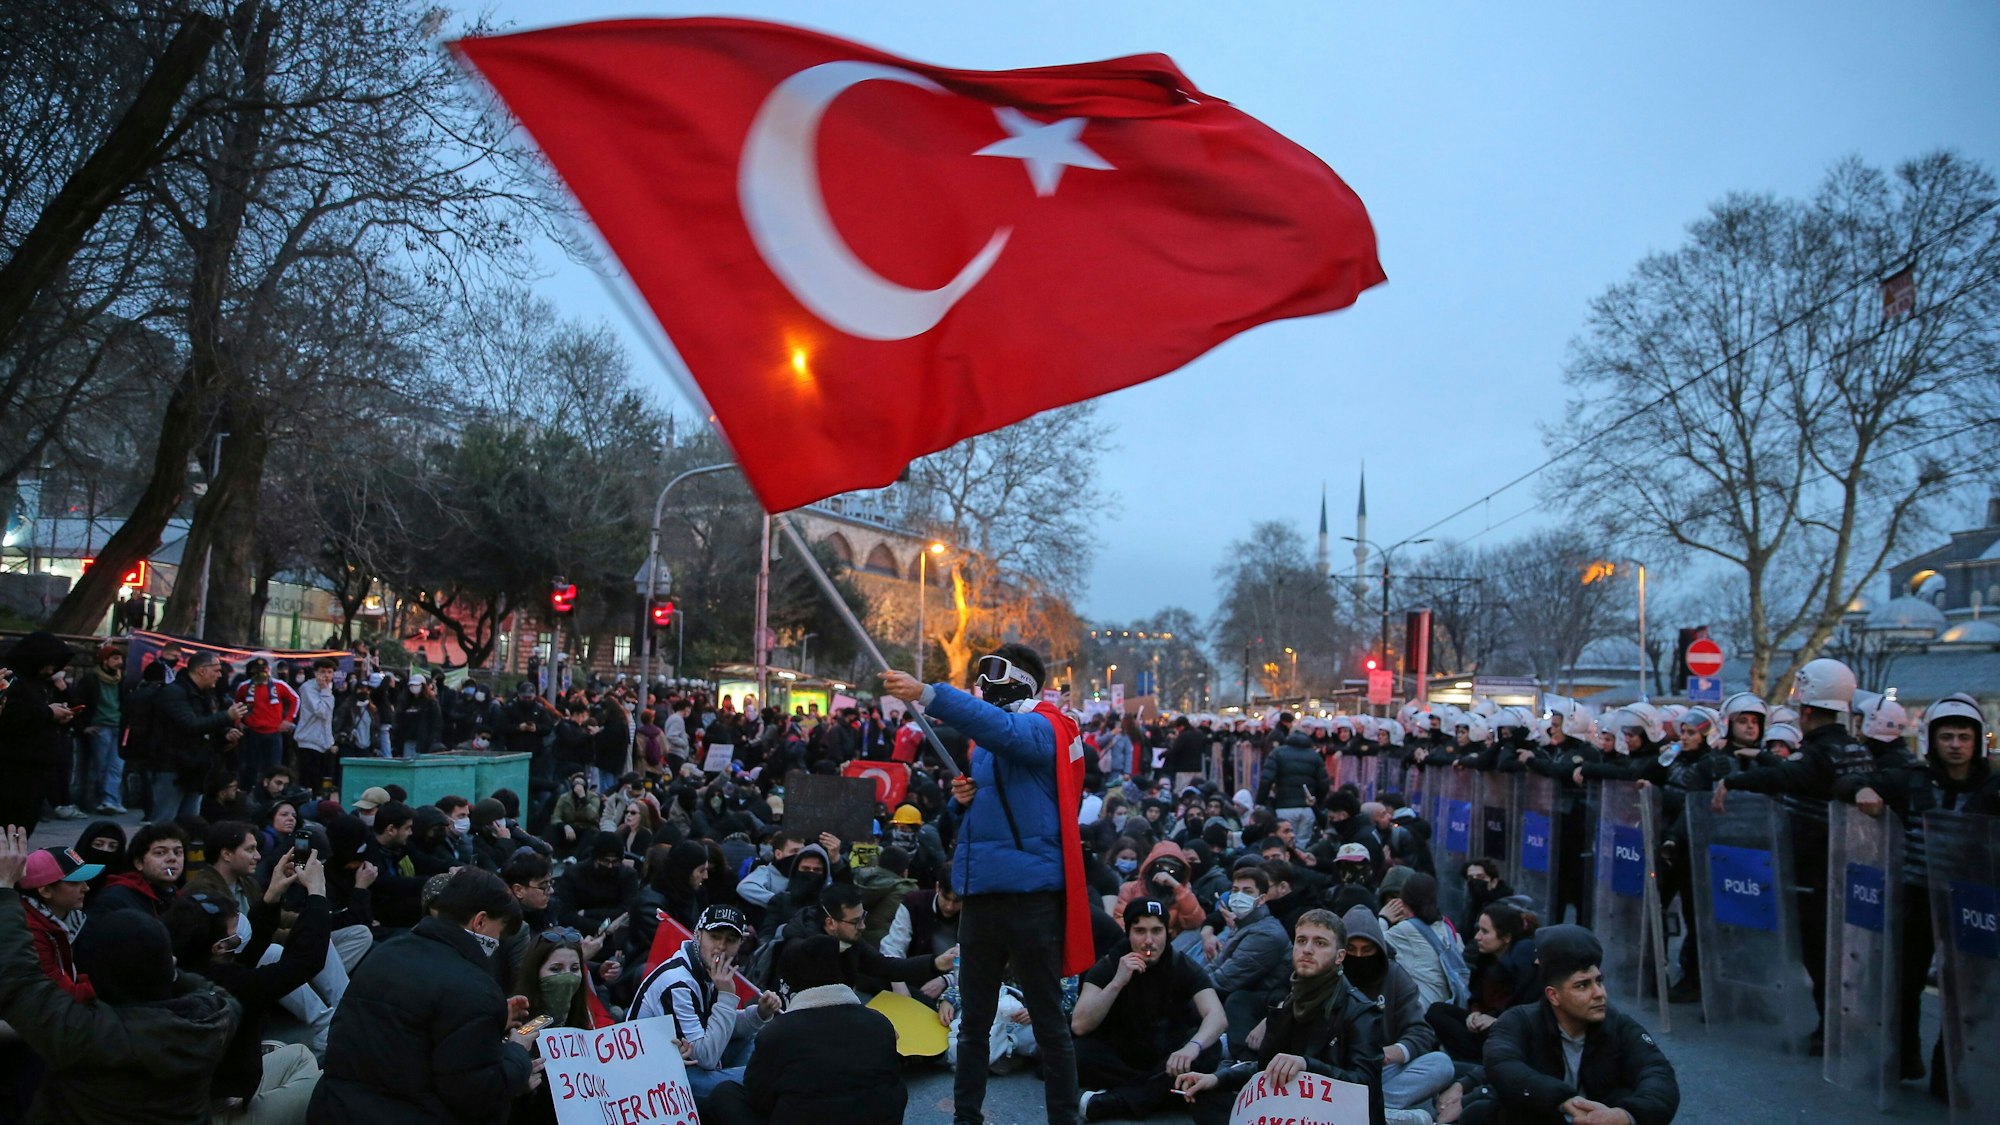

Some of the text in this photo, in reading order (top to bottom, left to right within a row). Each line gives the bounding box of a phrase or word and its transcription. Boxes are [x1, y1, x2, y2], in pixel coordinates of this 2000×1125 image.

[1724, 878, 1761, 896] POLİS
[1853, 884, 1880, 905] POLİS
[1962, 907, 1997, 932] POLİS
[595, 1024, 645, 1064] GİBİ
[559, 1073, 575, 1100] 3
